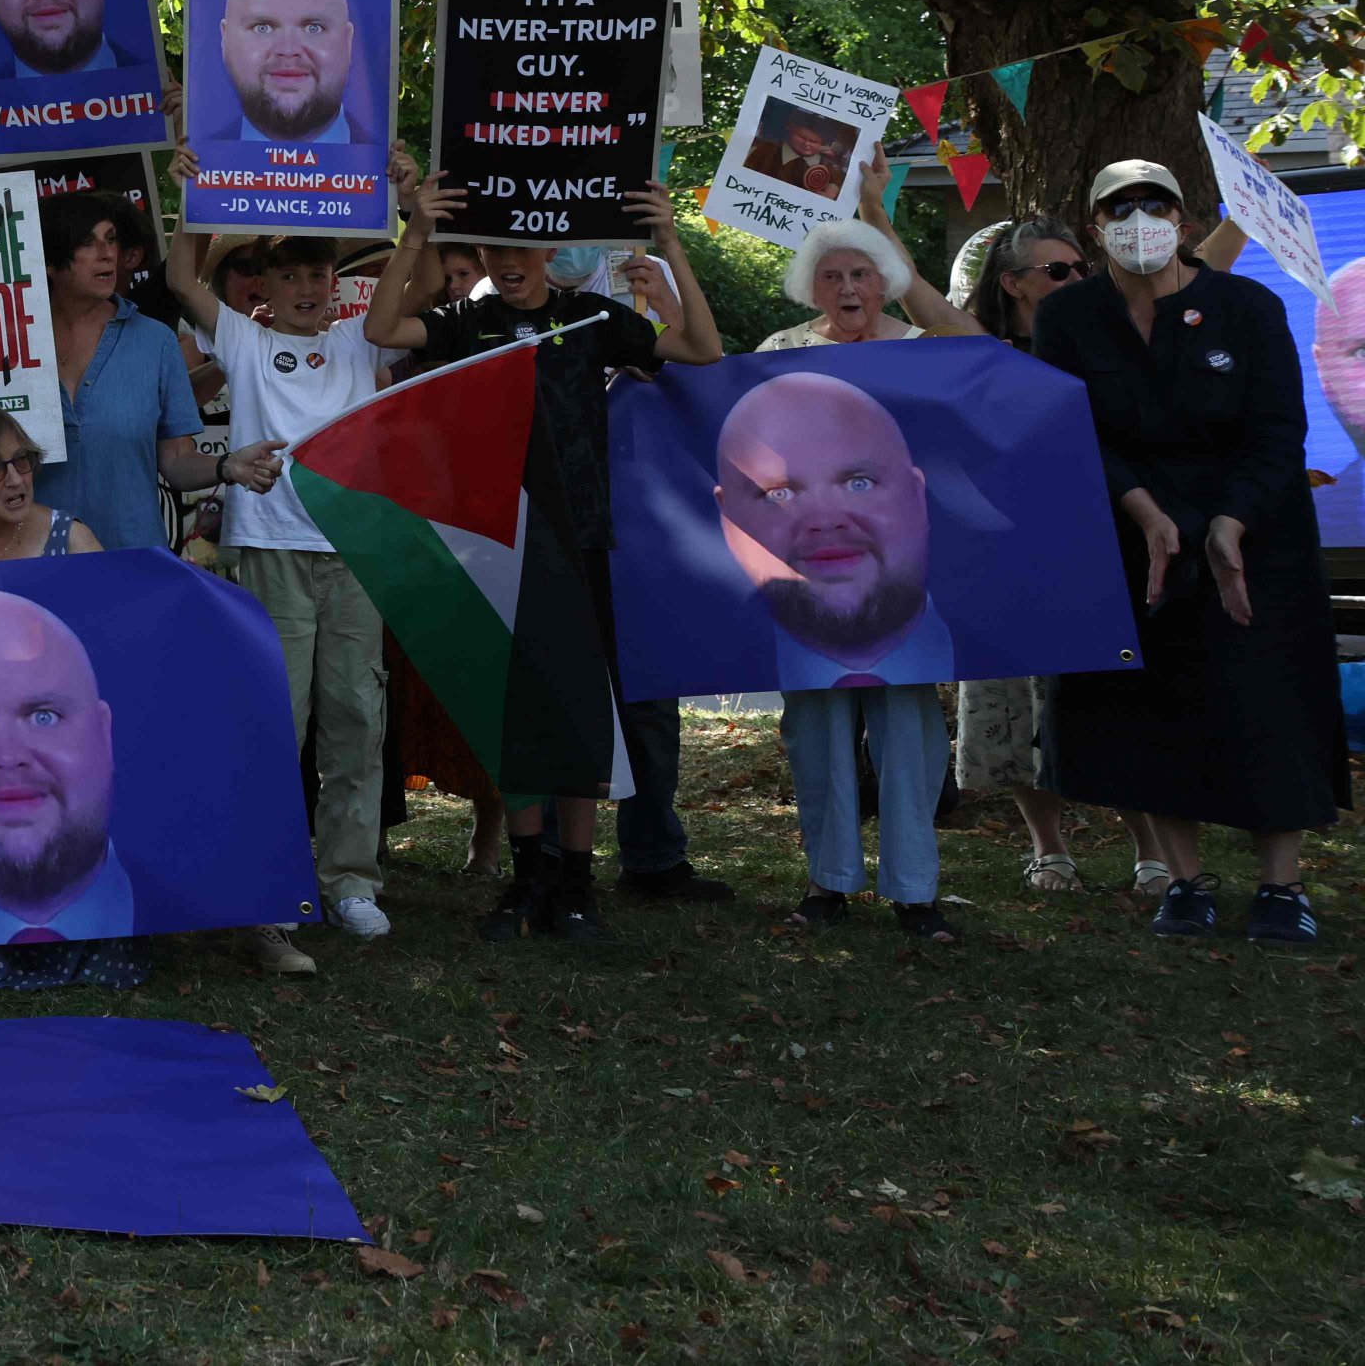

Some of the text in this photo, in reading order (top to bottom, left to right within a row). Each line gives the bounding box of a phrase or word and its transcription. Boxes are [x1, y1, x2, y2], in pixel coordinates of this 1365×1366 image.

[459, 17, 656, 42] NEVER-TRUMP
[517, 55, 585, 77] GUY.
[771, 54, 895, 108] ARE YOU WEARING
[84, 92, 155, 120] OUT!
[496, 91, 602, 113] I NEVER
[771, 74, 887, 122] A SUIT JD?
[474, 123, 619, 146] LIKED HIM.
[303, 149, 316, 164] A
[197, 170, 326, 188] NEVER-TRUMP
[527, 176, 623, 202] VANCE,
[255, 198, 313, 216] VANCE,
[317, 200, 351, 215] 2016
[726, 175, 814, 218] DON'T FORGET TO
[510, 210, 570, 232] 2016
[733, 201, 795, 232] THANK
[275, 359, 295, 369] TRUMP
[278, 355, 295, 363] STOP
